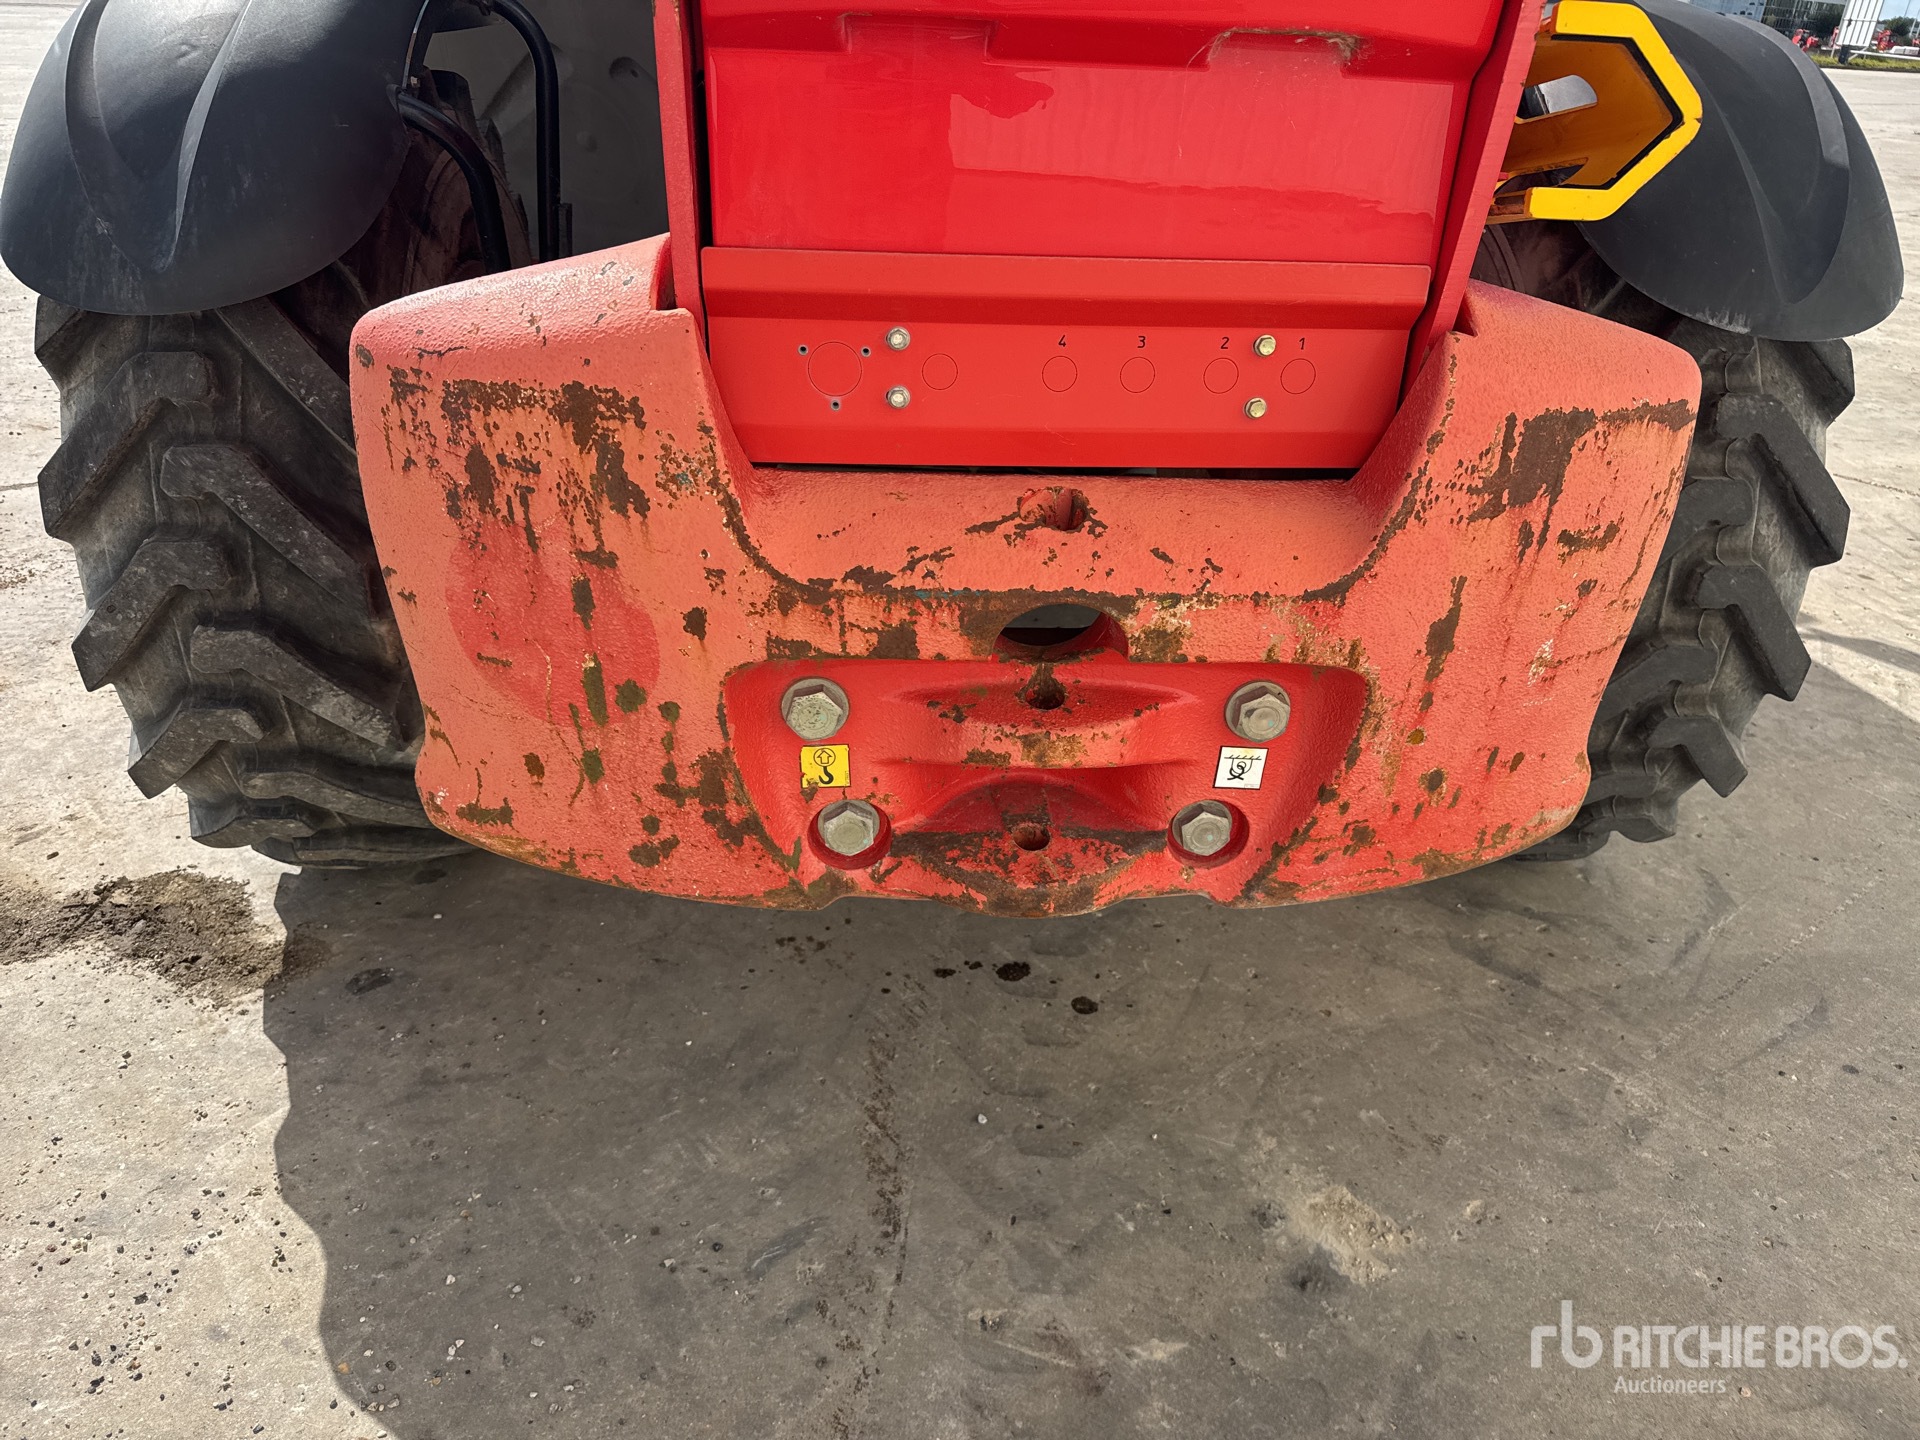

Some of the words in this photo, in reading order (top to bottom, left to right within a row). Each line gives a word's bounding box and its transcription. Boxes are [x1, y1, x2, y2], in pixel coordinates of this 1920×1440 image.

[1057, 334, 1067, 348] 4
[1137, 335, 1146, 349] 3
[1220, 336, 1230, 350] 2
[1298, 337, 1306, 350] 1
